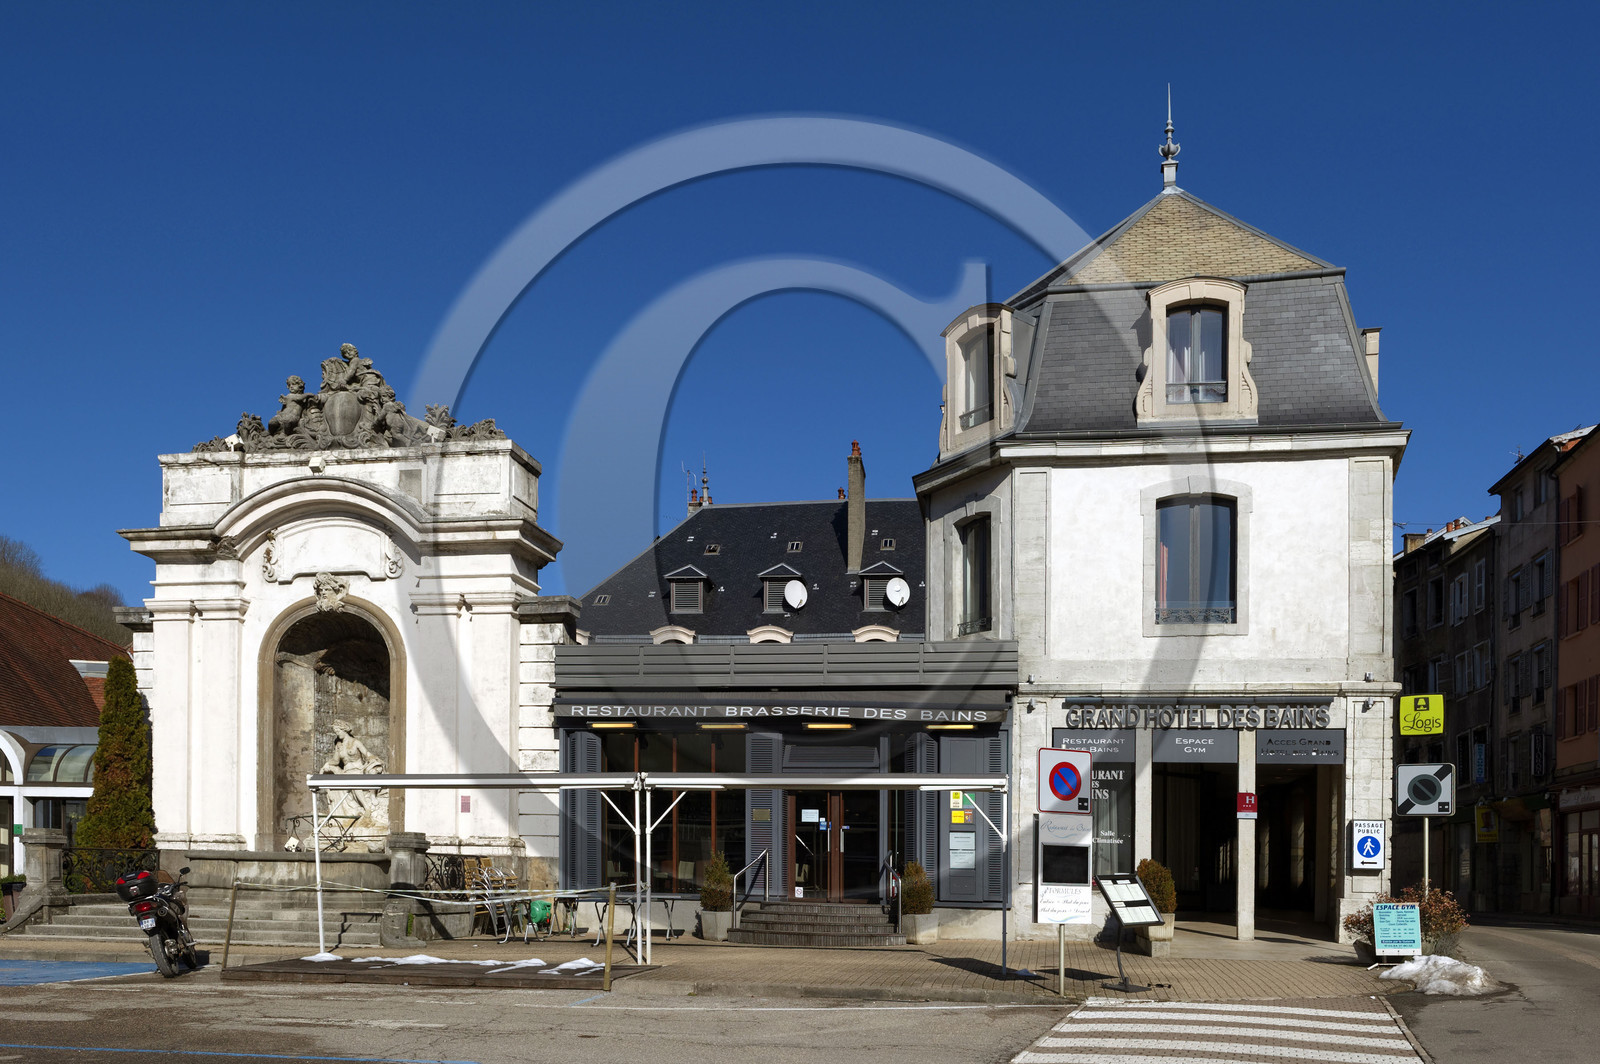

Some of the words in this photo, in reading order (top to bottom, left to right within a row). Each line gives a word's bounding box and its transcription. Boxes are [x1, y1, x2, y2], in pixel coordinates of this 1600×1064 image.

[571, 705, 712, 716] RESTAURANT
[725, 706, 851, 717] BRASSERIE
[863, 707, 908, 719] DES
[920, 710, 988, 721] BAINS
[1066, 704, 1140, 728] GRAND
[1146, 704, 1215, 727] HOTEL
[1219, 704, 1261, 728] DES
[1265, 704, 1331, 728] BAINS
[1402, 711, 1442, 732] Logis
[1246, 795, 1255, 804] H
